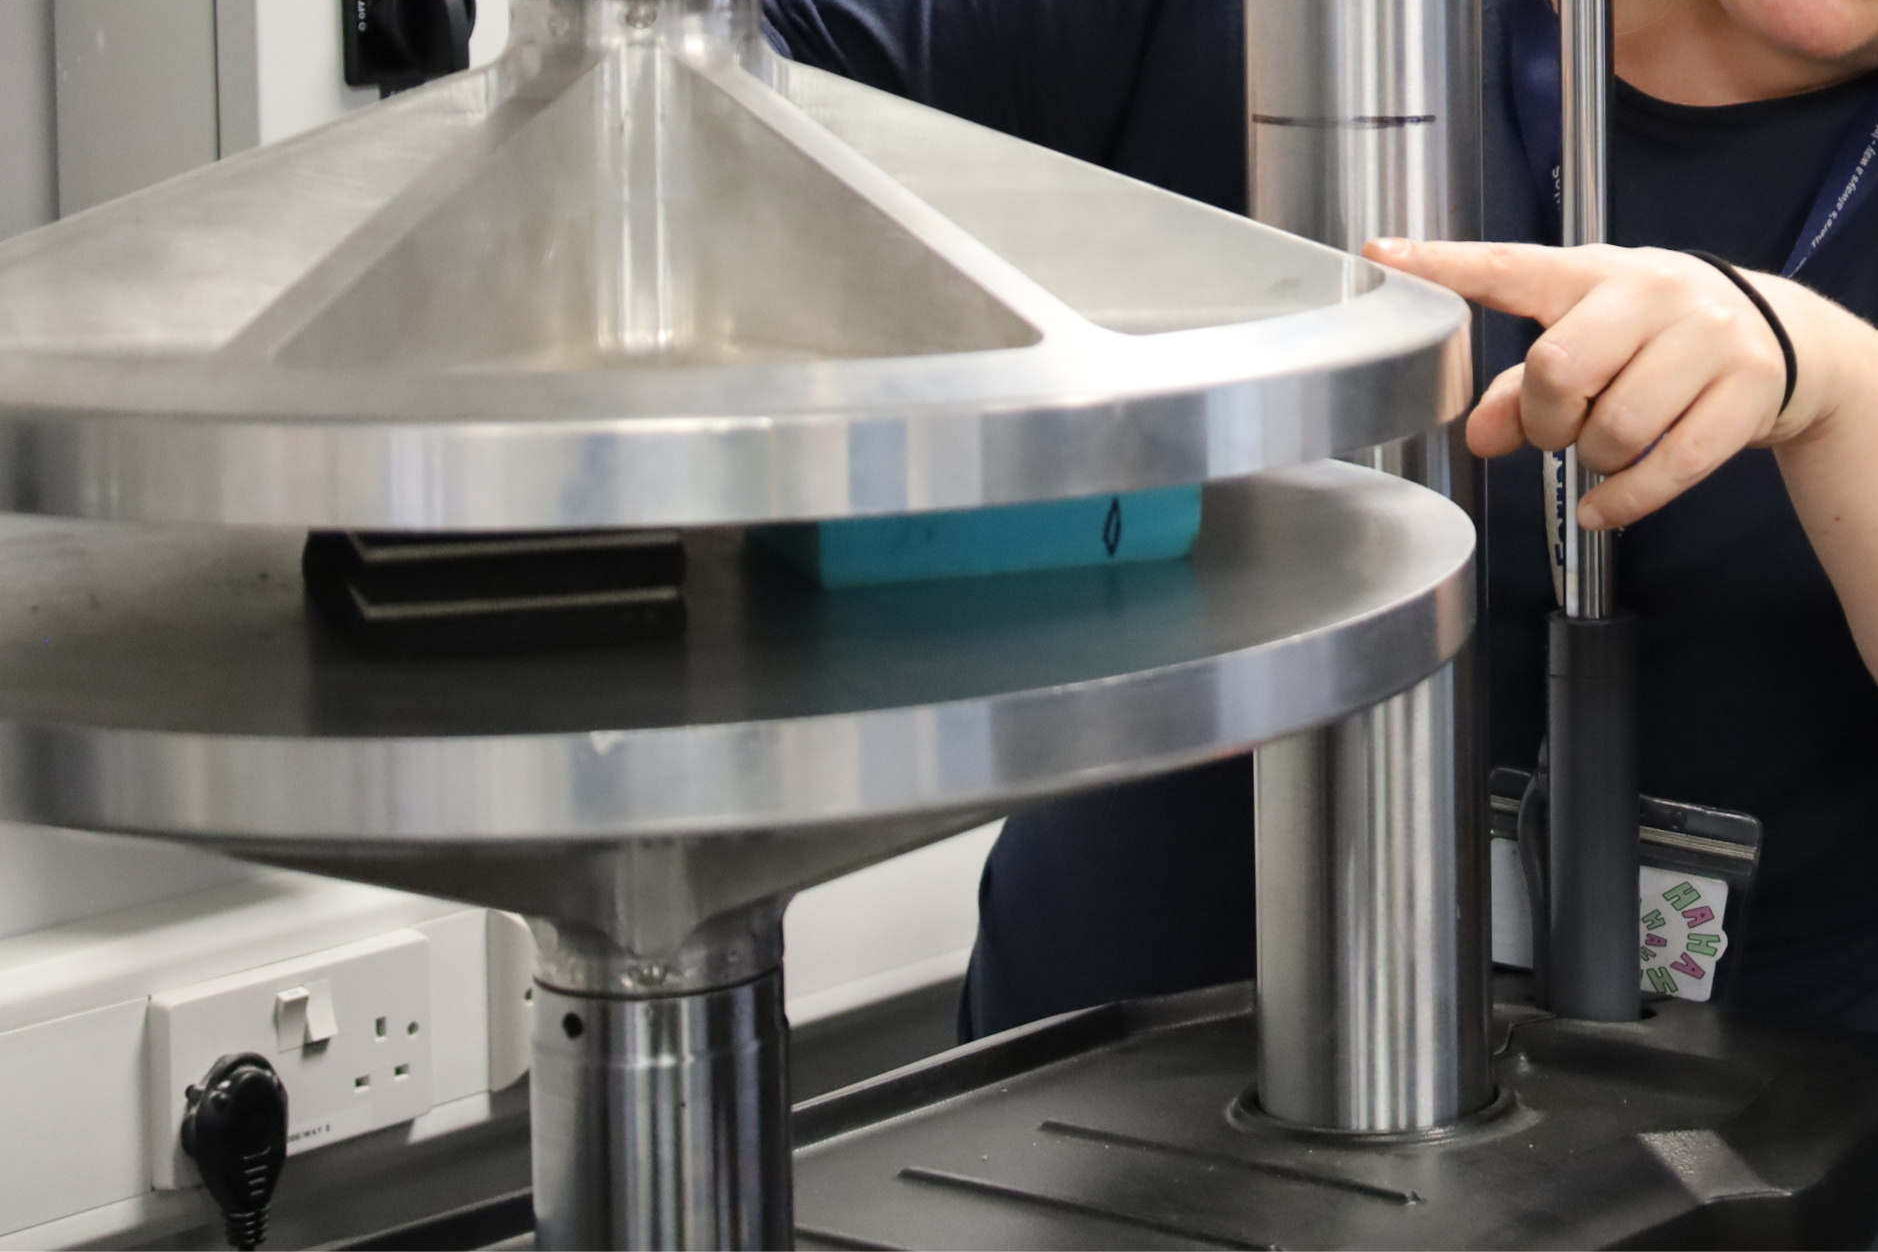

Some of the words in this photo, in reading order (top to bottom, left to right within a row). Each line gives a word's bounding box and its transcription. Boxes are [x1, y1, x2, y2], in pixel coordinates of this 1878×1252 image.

[1811, 210, 1838, 249] There's
[1835, 173, 1860, 212] always
[1859, 145, 1877, 167] way
